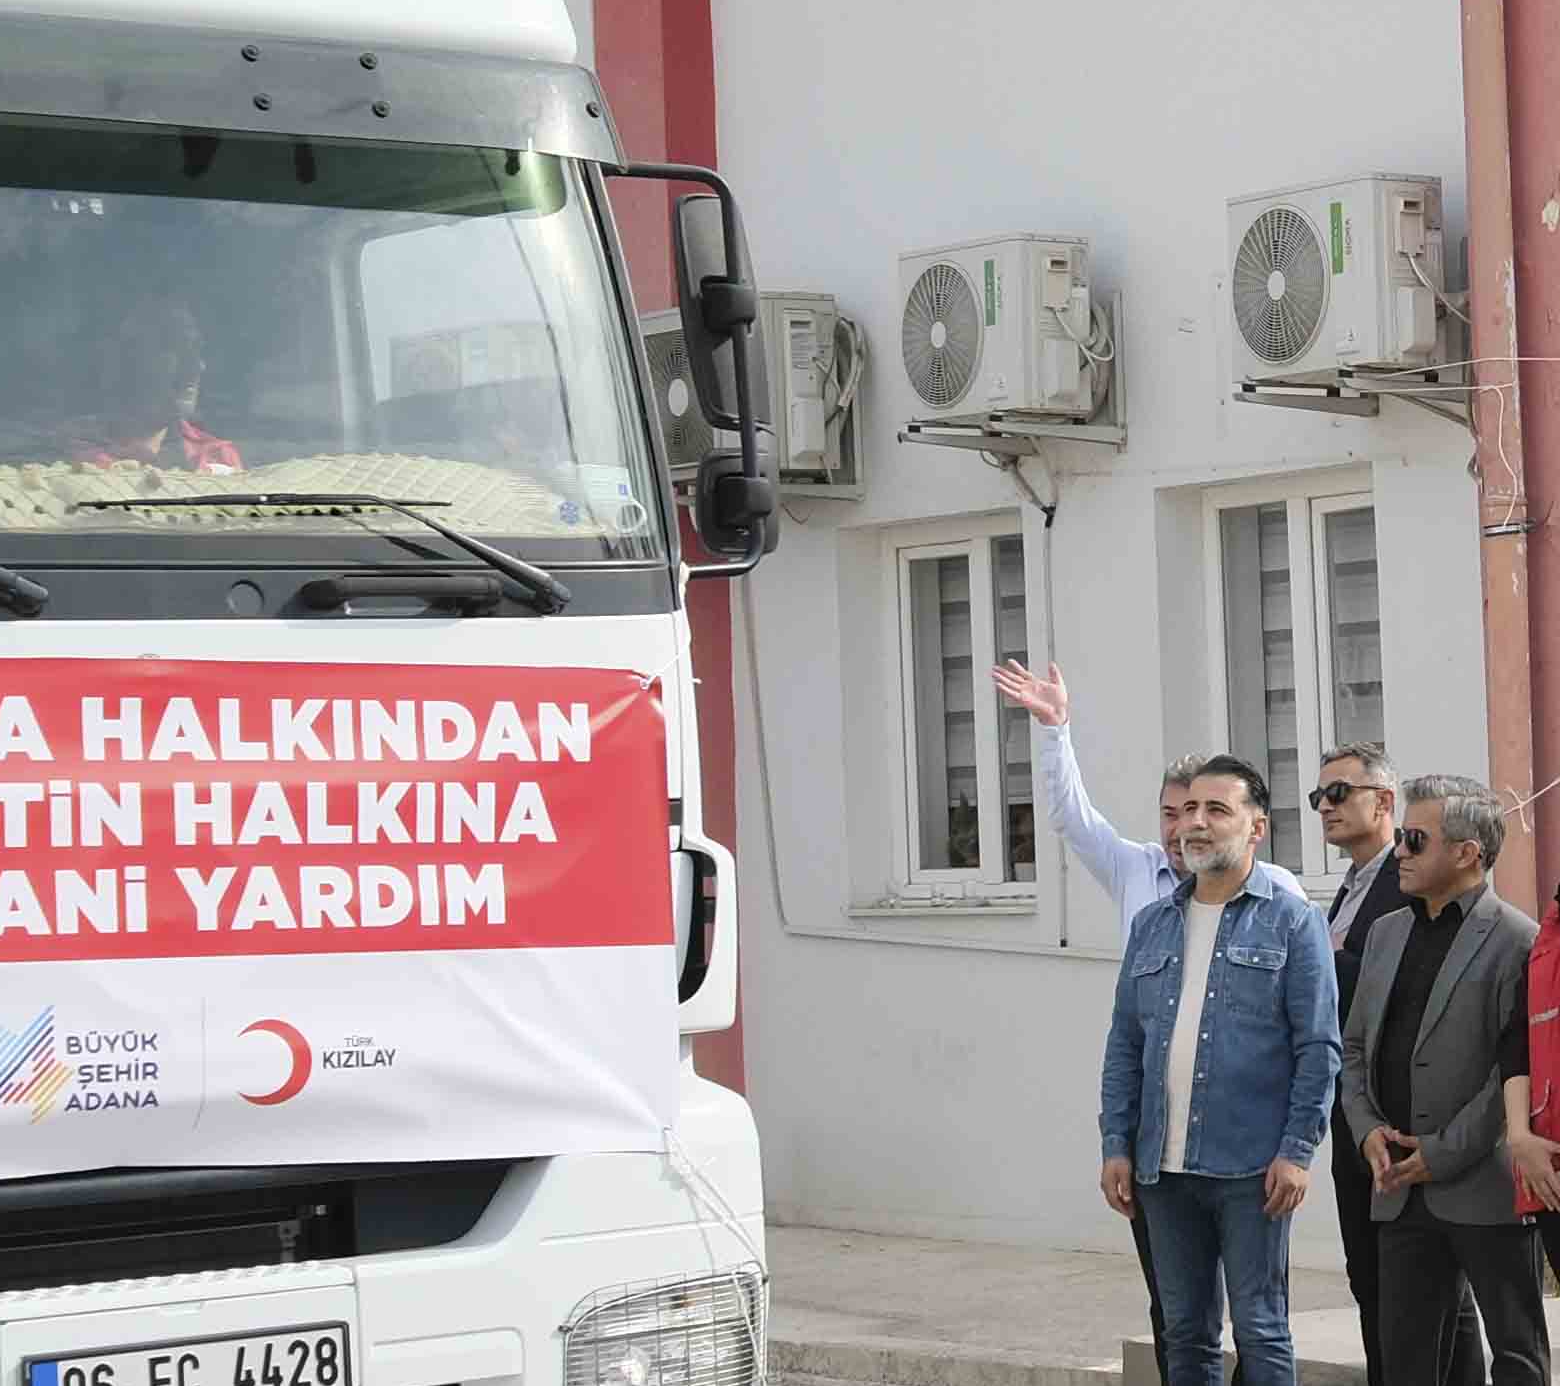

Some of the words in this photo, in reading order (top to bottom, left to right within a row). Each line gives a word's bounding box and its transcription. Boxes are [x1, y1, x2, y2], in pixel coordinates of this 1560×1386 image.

[82, 697, 595, 764] HALKINDAN
[171, 777, 557, 845] HALKINA
[175, 863, 506, 931] YARDIM
[66, 1030, 158, 1055] BÜYÜK
[77, 1058, 158, 1091] ŞEHİR
[322, 1049, 397, 1070] KIZILAY
[64, 1090, 159, 1112] ADANA
